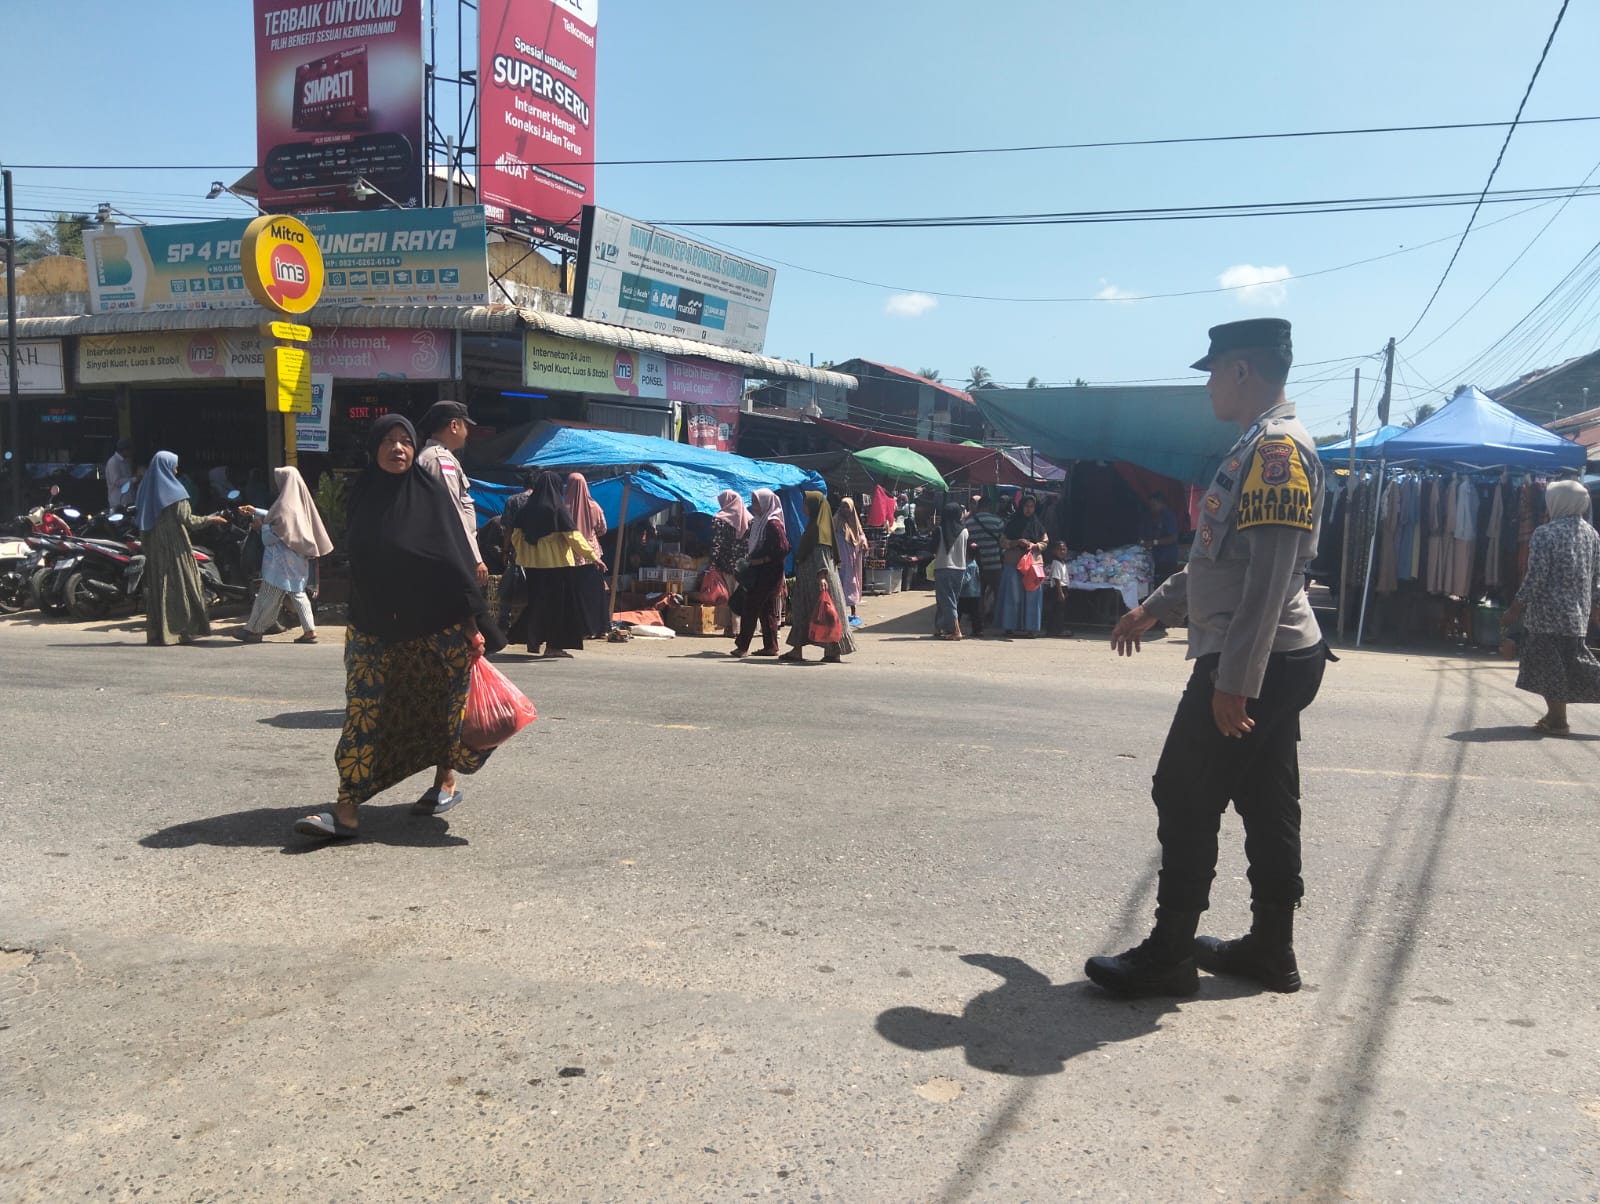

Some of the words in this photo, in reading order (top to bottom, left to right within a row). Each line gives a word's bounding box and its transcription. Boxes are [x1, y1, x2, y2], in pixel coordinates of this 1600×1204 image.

[264, 3, 322, 37] TERBAIK
[325, 0, 403, 25] UNTUKMU
[270, 38, 287, 51] PILIH
[288, 32, 316, 48] BENEFIT
[316, 29, 342, 43] SESUAI
[343, 21, 396, 39] KEINGINANMU
[563, 17, 594, 48] Telkomsel
[514, 36, 544, 61] Spesial
[303, 70, 353, 105] SIMPATI
[494, 56, 554, 98] SUPER
[554, 80, 589, 126] SERU
[515, 96, 551, 123] Internet
[551, 112, 576, 135] Hemat
[505, 111, 541, 137] Koneksi
[542, 128, 562, 146] Jalan
[563, 136, 582, 156] Terus
[502, 158, 529, 180] KUAT
[271, 224, 304, 243] Mitra
[167, 242, 195, 263] SP
[197, 241, 211, 261] 4
[391, 229, 457, 251] RAYA
[275, 256, 305, 284] im3
[660, 292, 678, 310] BCA
[86, 347, 126, 357] Internetan
[127, 345, 137, 354] 24
[138, 344, 155, 354] Jam
[190, 343, 215, 361] im3
[342, 335, 391, 351] hemat,
[86, 359, 109, 371] Sinyal
[131, 358, 149, 367] Luas
[150, 356, 156, 366] &
[157, 355, 180, 366] Stabil
[231, 354, 264, 365] PONSE
[532, 346, 570, 361] Internetan
[570, 352, 577, 360] 24
[578, 353, 592, 364] Jam
[532, 361, 554, 374] Sinyal
[555, 363, 572, 376] Kuat,
[572, 367, 586, 376] Luas
[587, 368, 591, 377] &
[592, 368, 609, 379] Stabil
[615, 359, 633, 380] im3
[646, 363, 654, 373] SP
[641, 375, 664, 387] PONSEL
[349, 407, 369, 418] SINI
[1242, 487, 1310, 509] BHABIN
[1237, 503, 1313, 526] KAMTIBMAS
